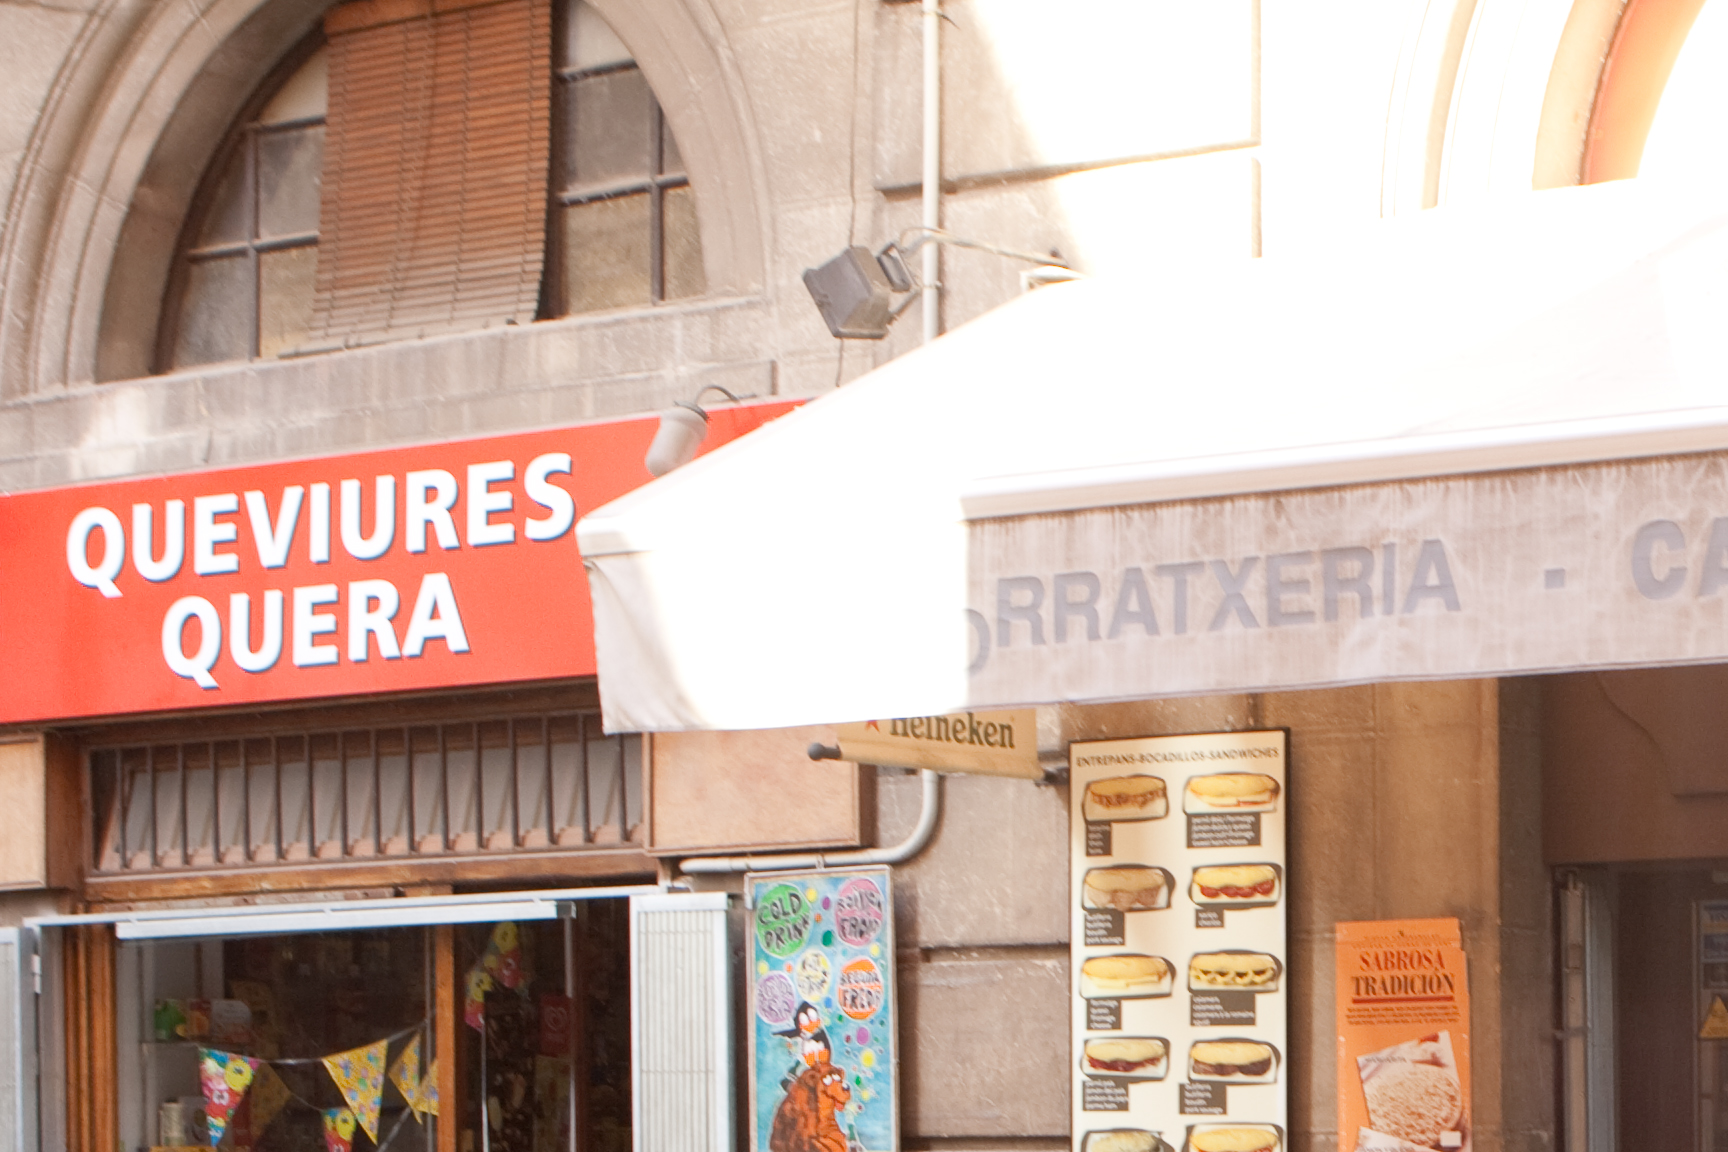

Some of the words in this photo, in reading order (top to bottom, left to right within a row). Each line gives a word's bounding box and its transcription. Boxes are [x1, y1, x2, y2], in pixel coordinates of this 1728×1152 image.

[66, 452, 576, 598] QUEVIURES
[161, 572, 470, 689] QUERA
[758, 892, 802, 926] COLD
[1360, 949, 1445, 972] SABROSA
[1351, 967, 1455, 996] TRADICIÓN
